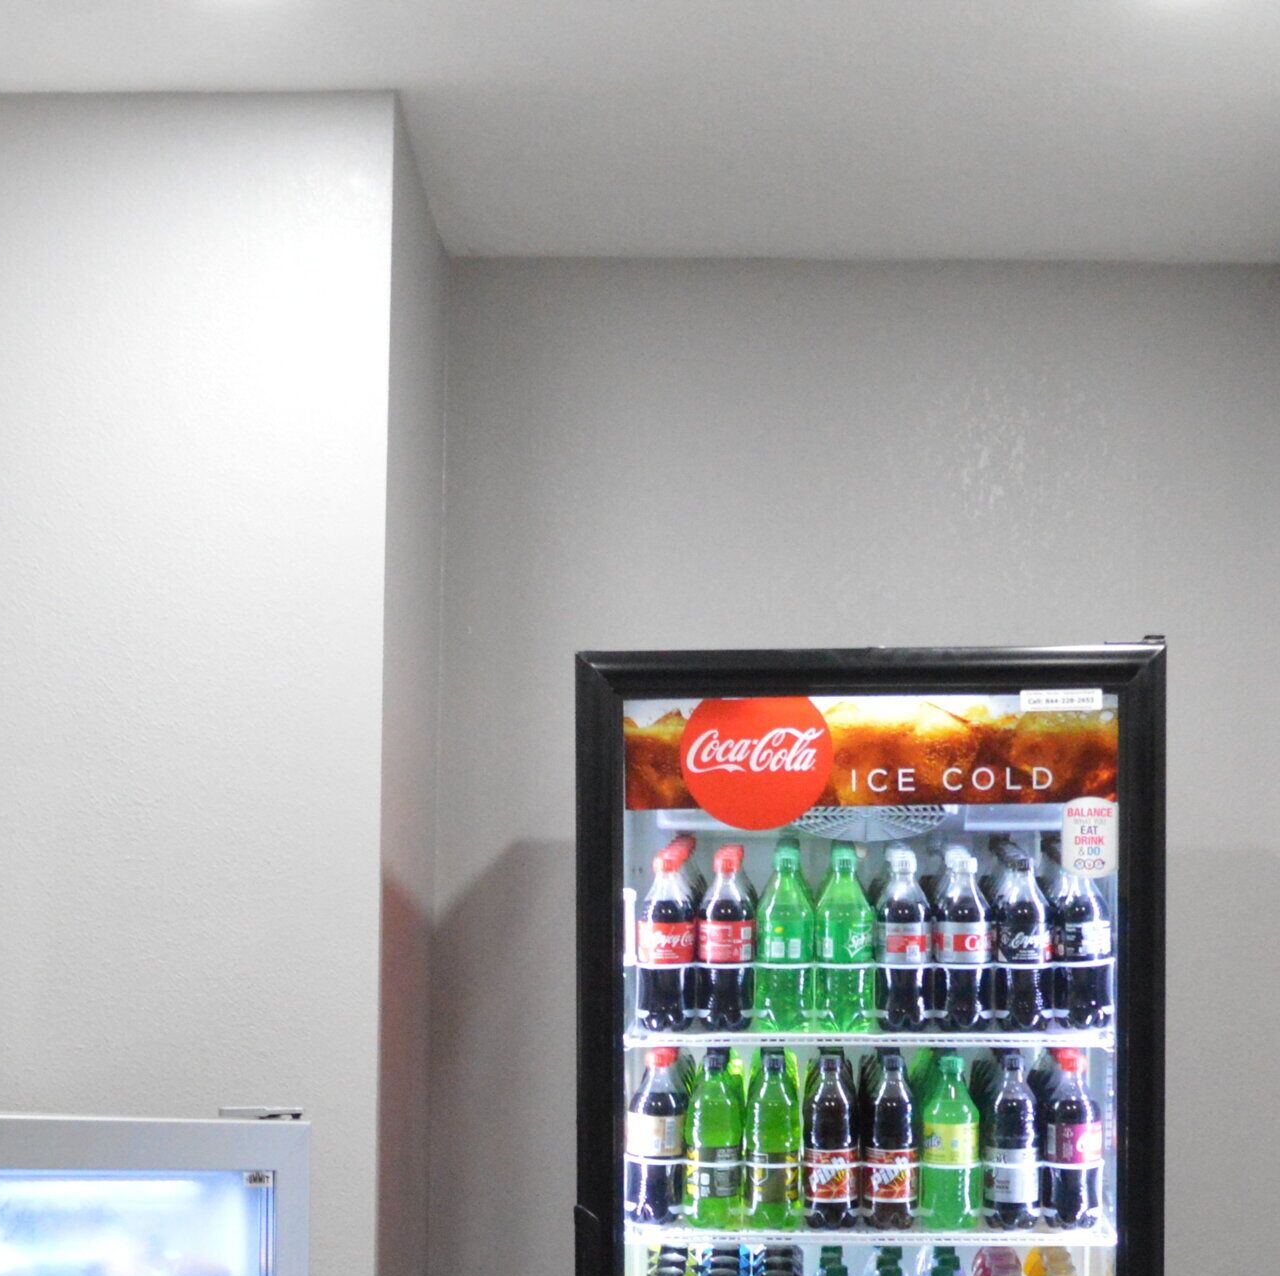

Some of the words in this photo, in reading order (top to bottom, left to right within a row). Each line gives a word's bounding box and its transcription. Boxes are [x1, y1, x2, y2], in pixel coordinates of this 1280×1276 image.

[686, 726, 825, 774] Coca-Cola
[850, 768, 916, 793] ICE
[941, 766, 1055, 792] COLD
[1067, 807, 1113, 817] BALANCE
[1080, 825, 1098, 835] EAT
[1074, 836, 1105, 845] DRINK
[1087, 847, 1101, 856] DO
